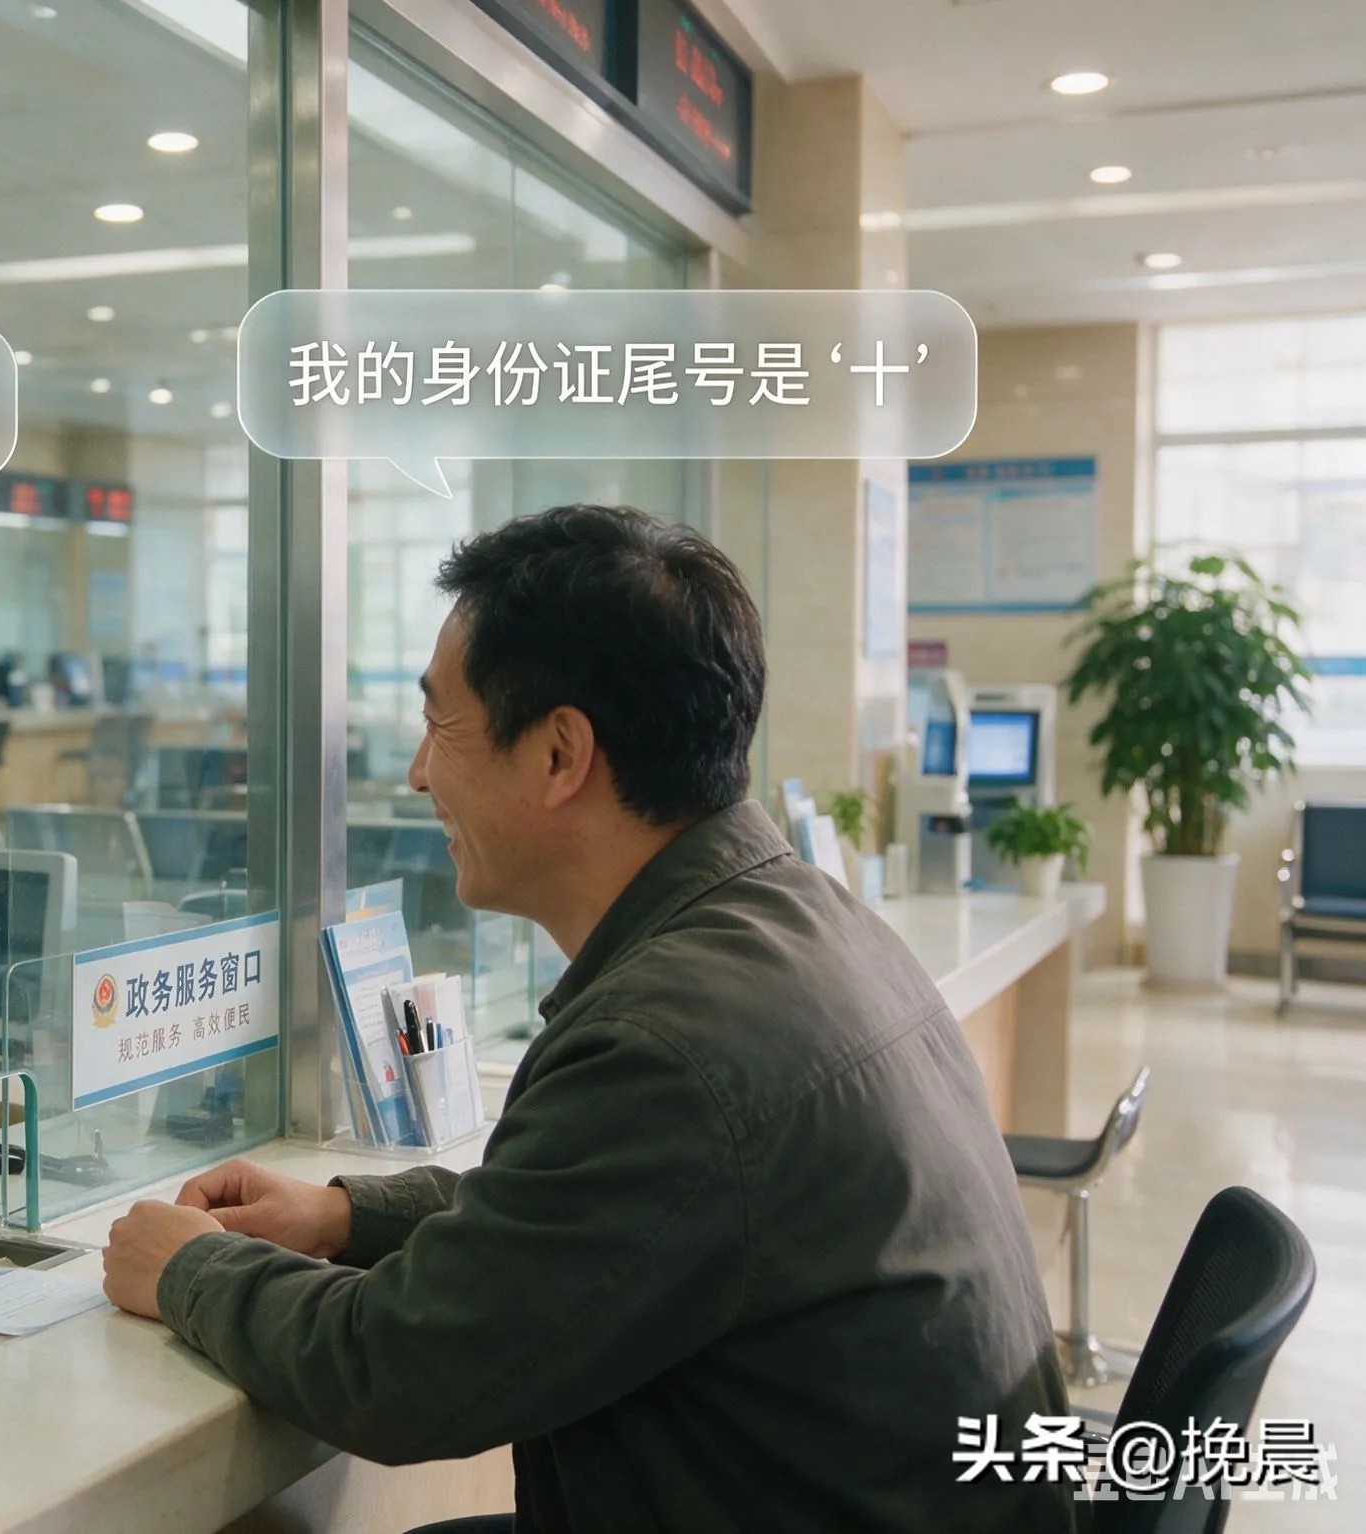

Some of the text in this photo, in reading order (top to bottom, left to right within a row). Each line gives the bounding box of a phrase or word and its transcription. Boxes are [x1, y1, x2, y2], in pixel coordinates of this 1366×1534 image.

[126, 950, 261, 1018] 政务服务窗口
[118, 1003, 250, 1063] 规范服务 高效便民
